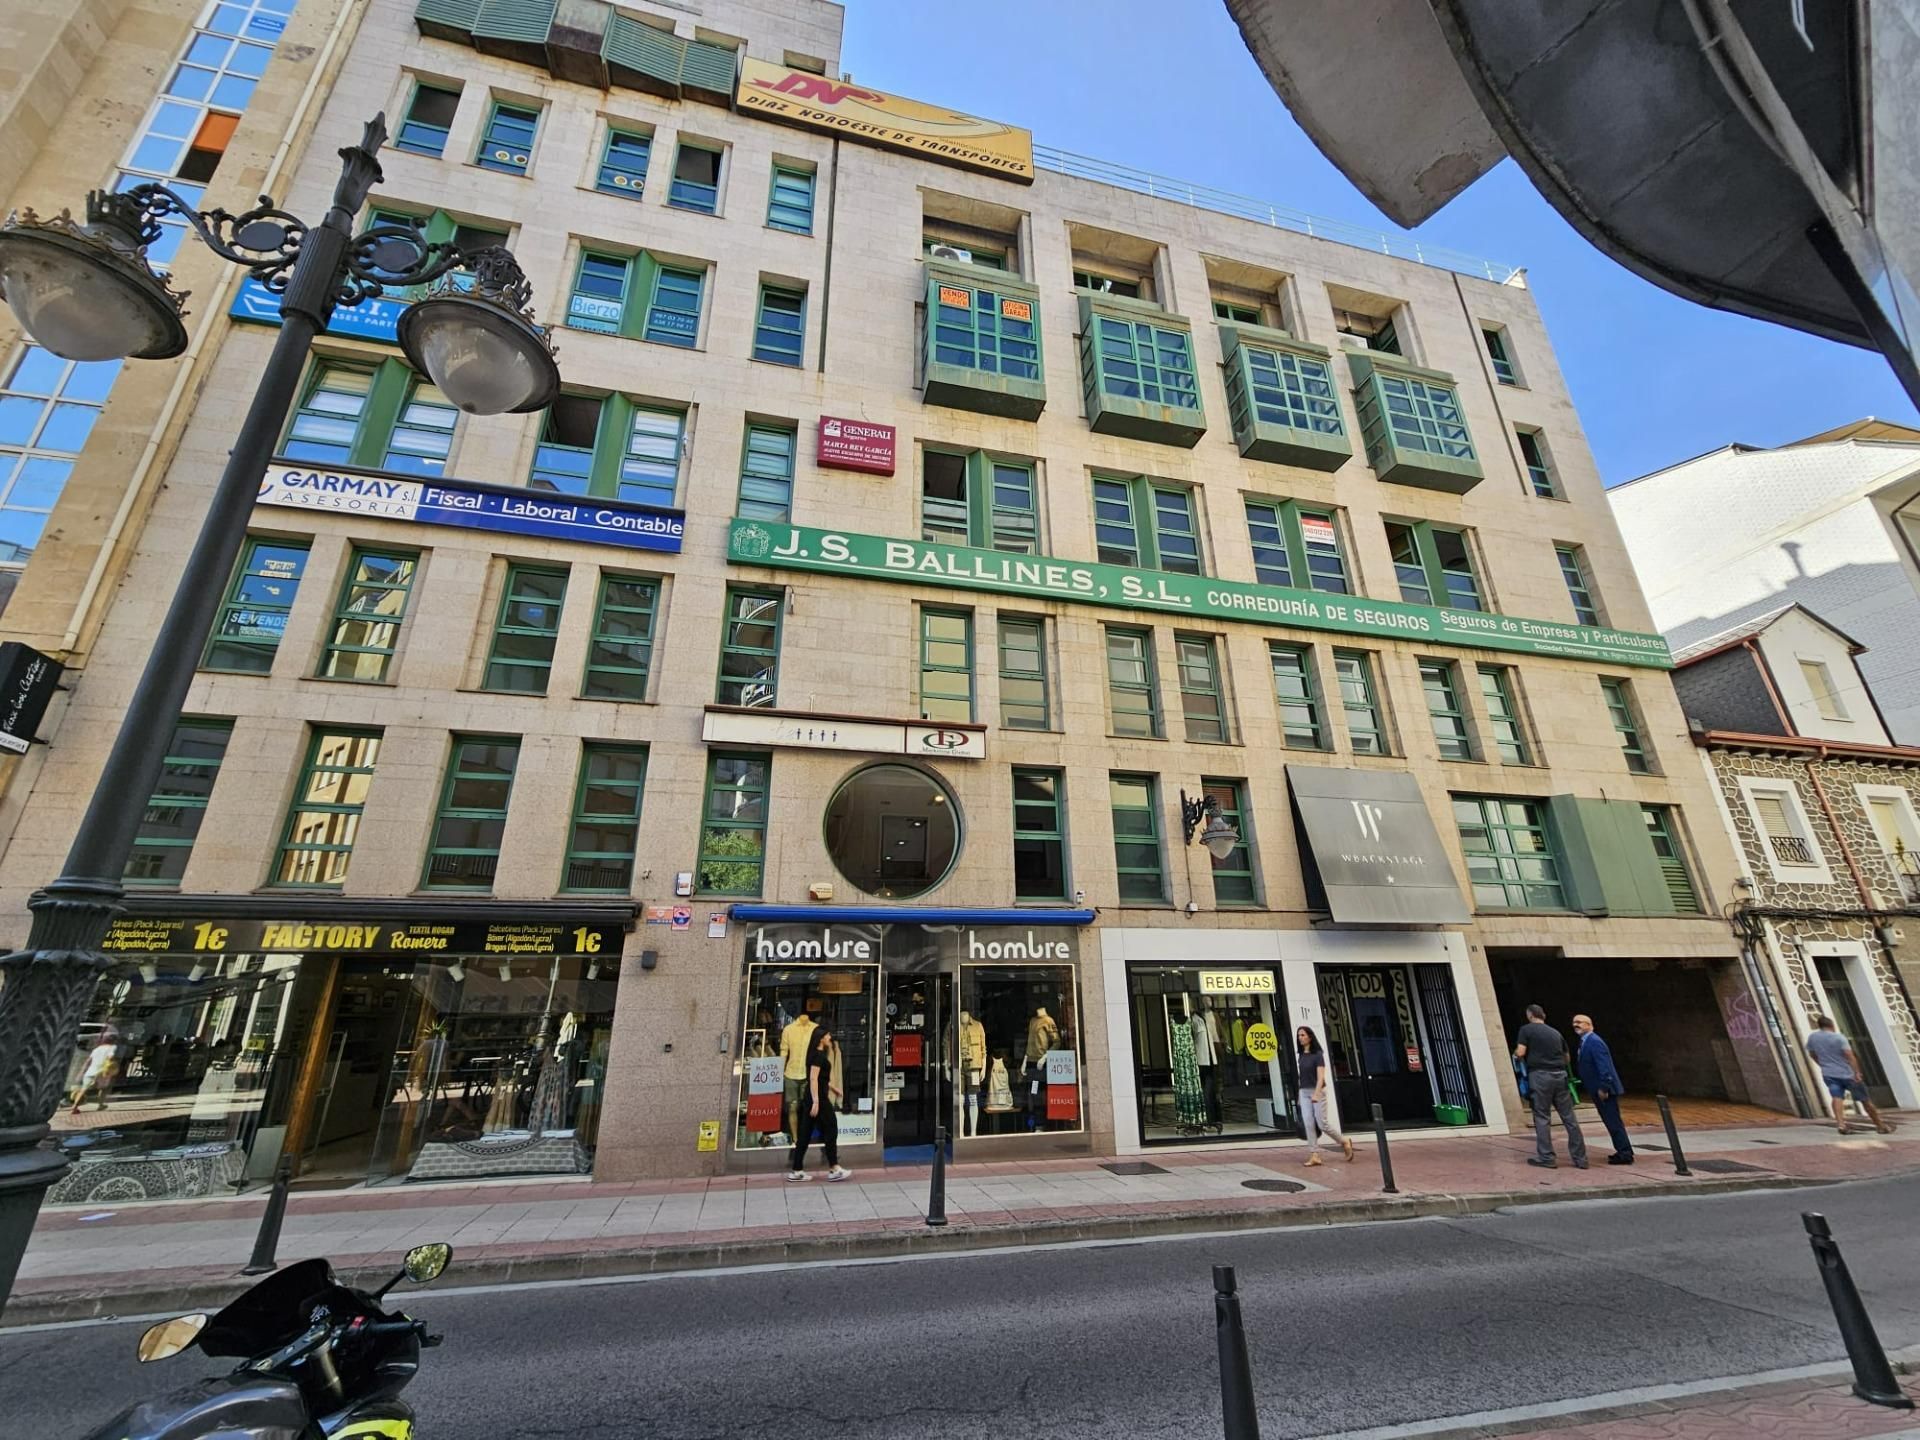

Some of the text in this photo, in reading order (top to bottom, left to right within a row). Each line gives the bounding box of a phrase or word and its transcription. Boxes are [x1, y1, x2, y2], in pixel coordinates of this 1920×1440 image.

[746, 96, 789, 112] DIAZ
[799, 109, 888, 136] NOROESTE
[892, 132, 915, 143] DE
[920, 139, 1027, 172] TRANSPORTES
[943, 289, 967, 298] VENDO
[573, 297, 619, 318] Bierzo
[843, 425, 891, 440] GENERALI
[823, 440, 892, 456] MARTA REY GARCÍA
[282, 471, 402, 499] GARMAY
[425, 488, 683, 535] Fiscal Laboral Contable
[1121, 575, 1192, 604] S.L.
[230, 611, 289, 627] SE VENDE
[1207, 590, 1431, 632] CORREDURÍA DE SEGUROS
[1440, 610, 1667, 651] Seguros de Empresa y Particulares
[194, 922, 228, 950] 1€
[261, 926, 382, 948] FACTORY
[390, 931, 448, 949] Romero
[409, 925, 455, 935] TEXTIL HOGAR
[573, 927, 602, 953] 1€
[756, 928, 870, 959] hombre
[969, 930, 1070, 960] hombre
[1205, 976, 1271, 988] REBAJAS
[750, 1108, 778, 1116] REBAJAS
